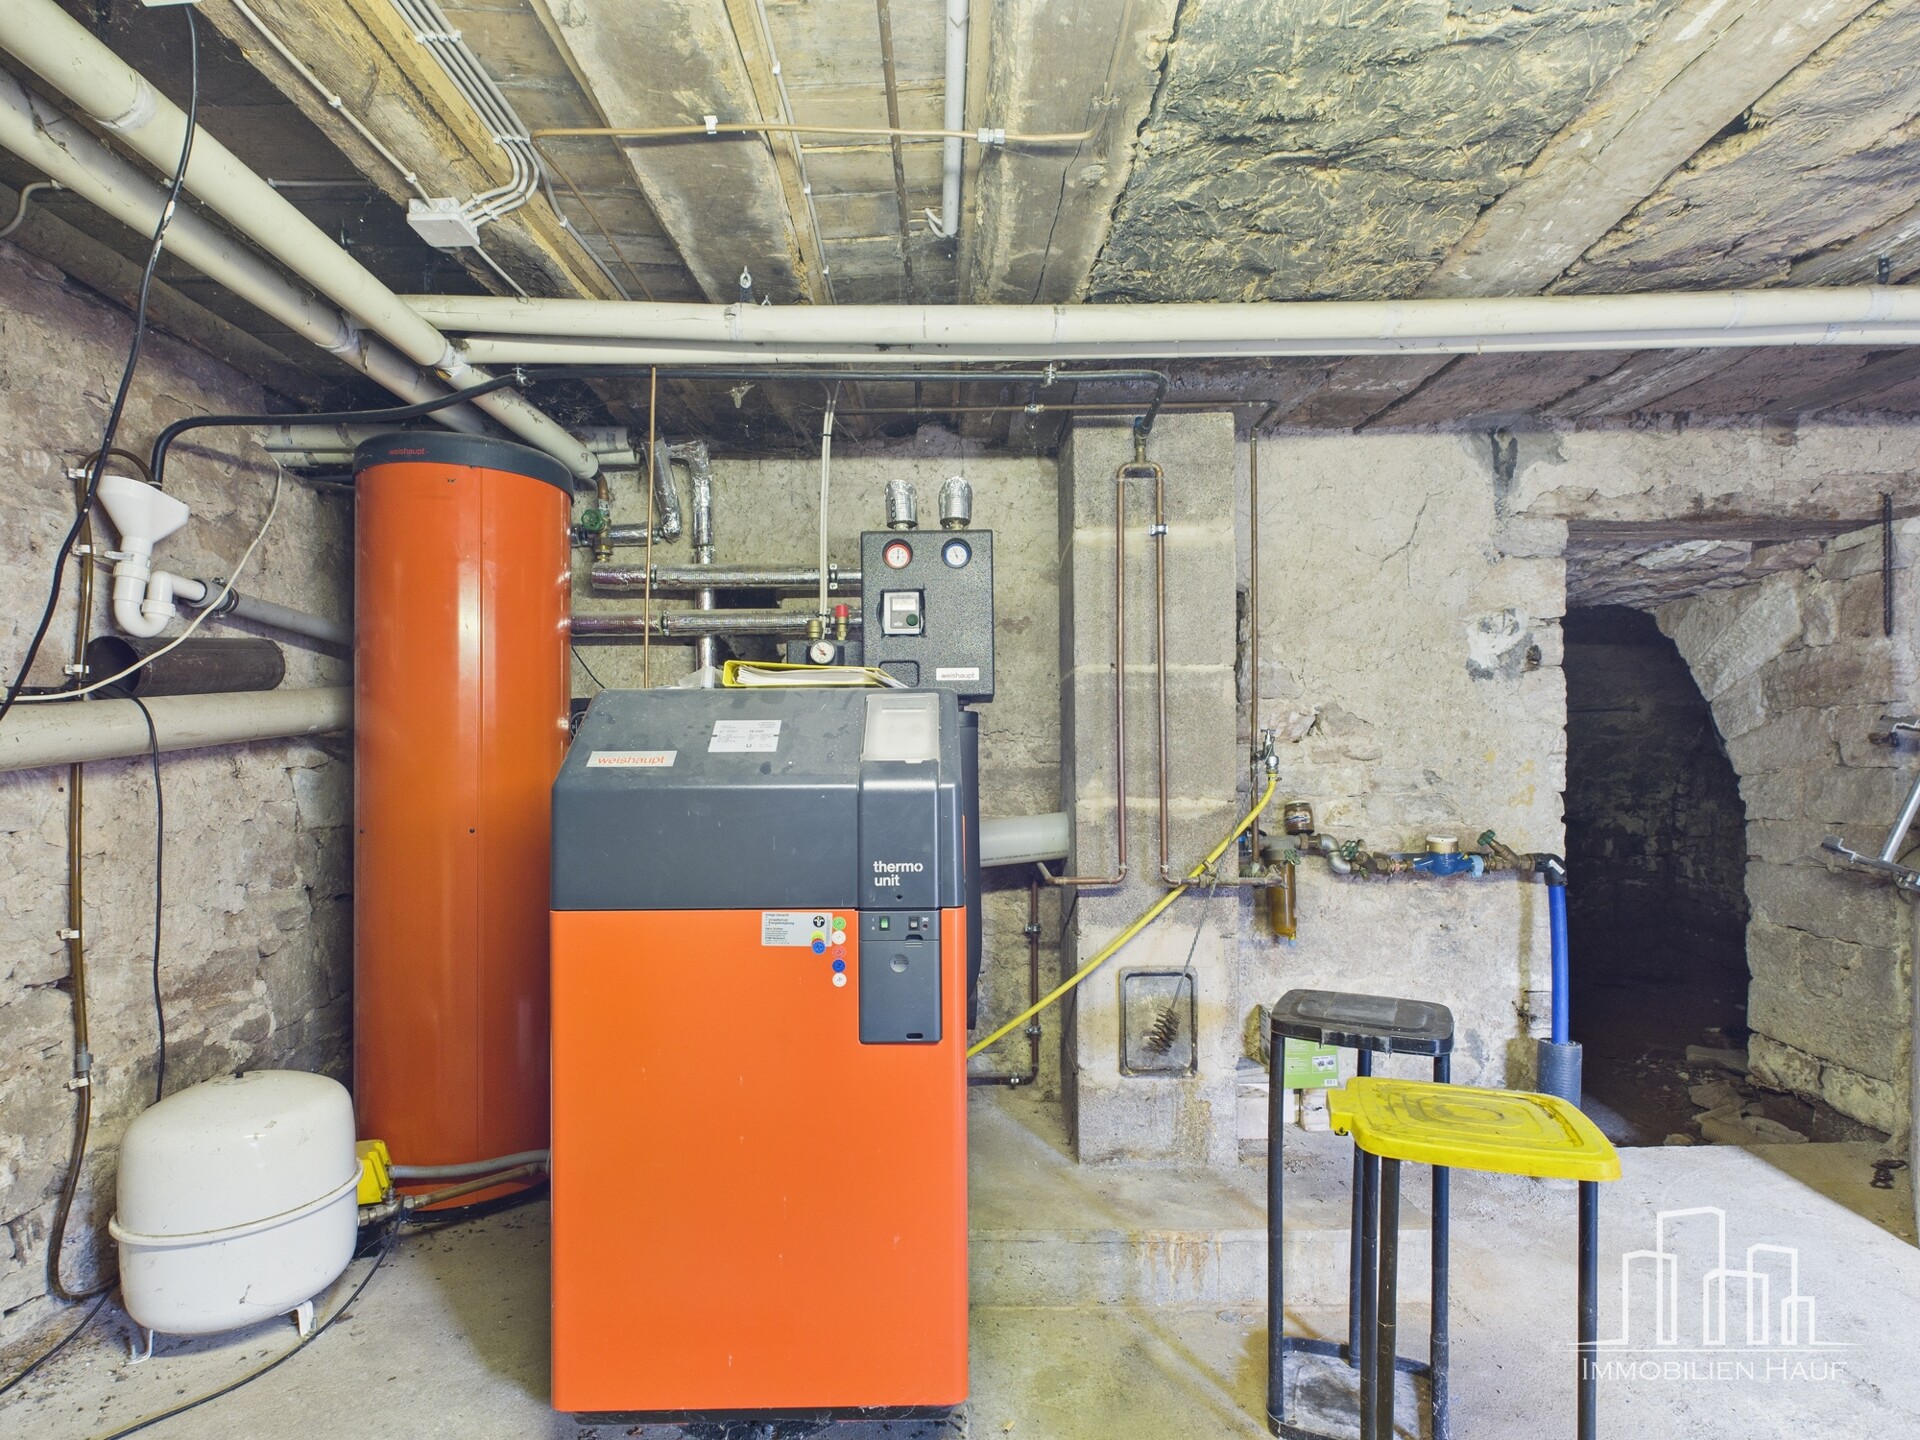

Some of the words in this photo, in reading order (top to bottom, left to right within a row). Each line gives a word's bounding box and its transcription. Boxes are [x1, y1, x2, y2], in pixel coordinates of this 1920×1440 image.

[940, 672, 975, 680] weishaupt
[597, 755, 665, 765] weishaupt
[872, 860, 924, 873] thermo
[874, 873, 901, 887] unit
